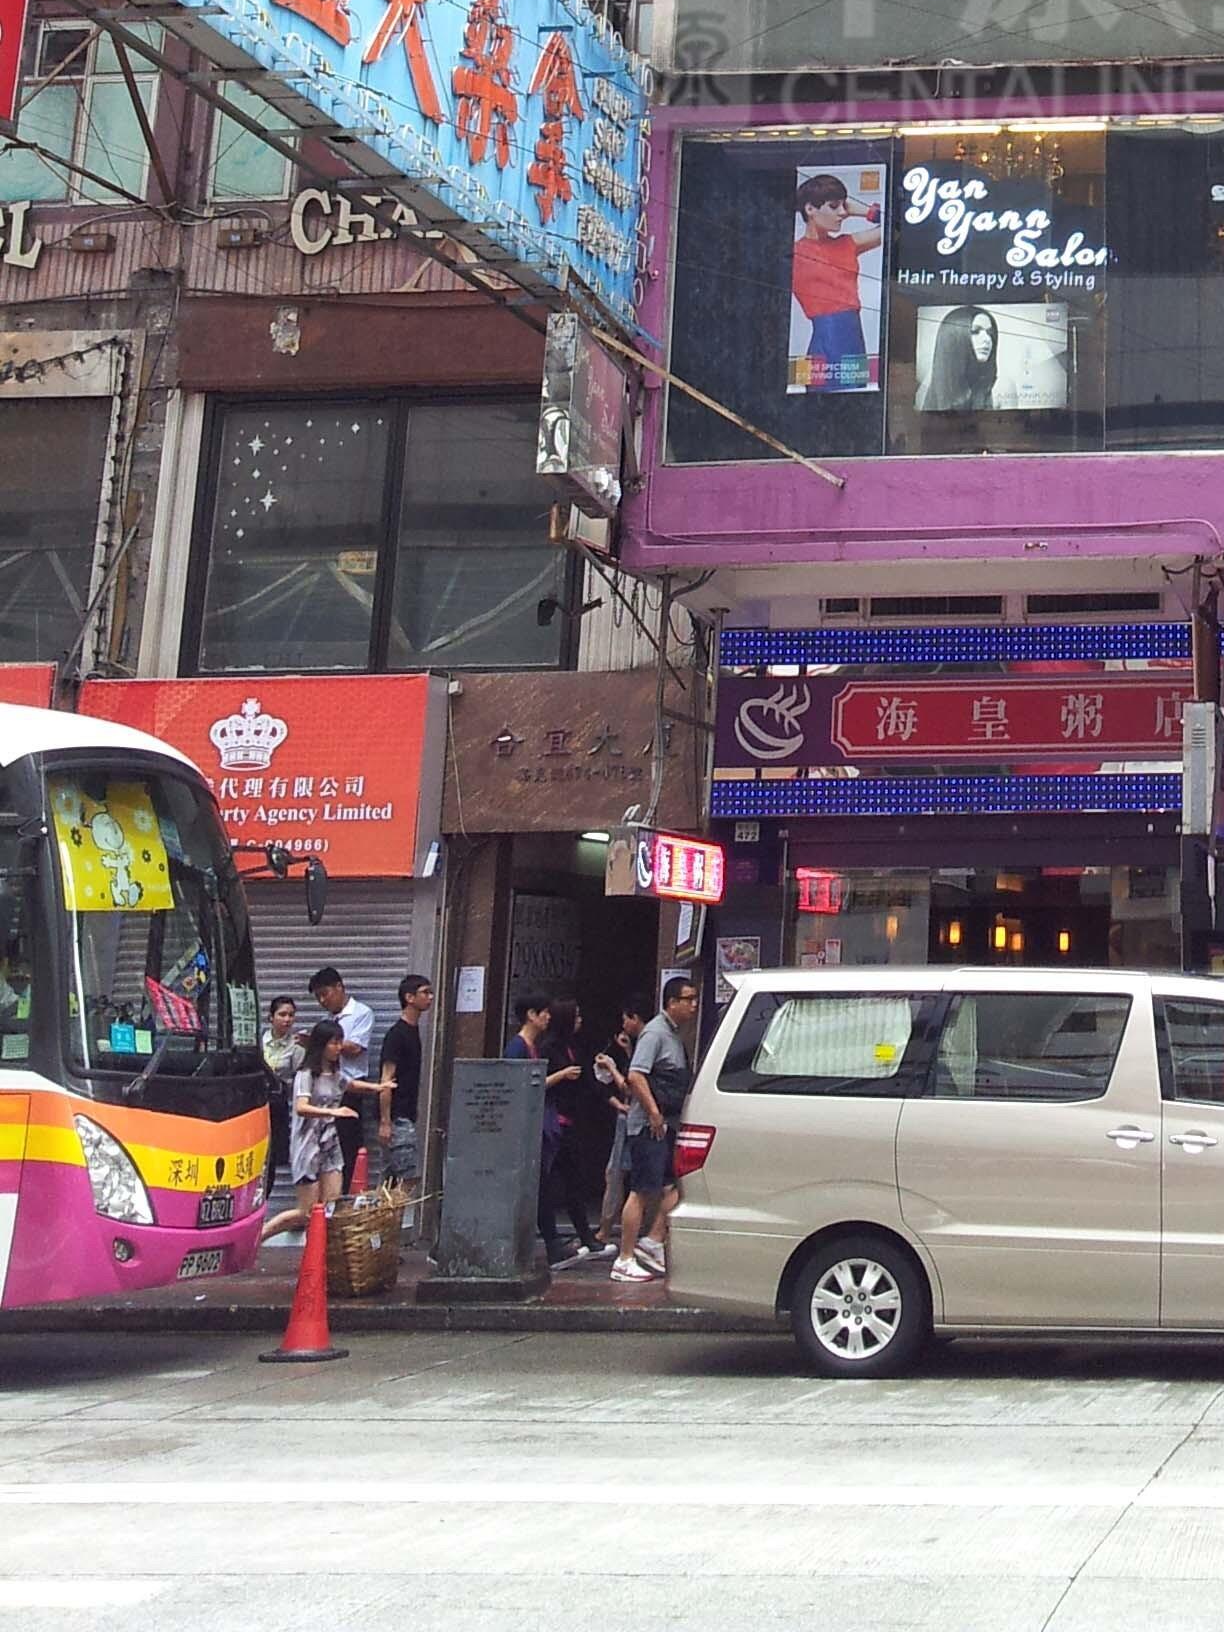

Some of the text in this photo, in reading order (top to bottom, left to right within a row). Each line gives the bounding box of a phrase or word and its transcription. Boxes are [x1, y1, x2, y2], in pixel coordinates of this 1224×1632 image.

[903, 167, 988, 225] Yan
[936, 199, 1051, 256] Yann
[897, 269, 1096, 290] Hair Therapy & Styling
[206, 776, 365, 800] 代理有限公司
[254, 803, 319, 826] Agency
[322, 801, 393, 821] Limited
[168, 1157, 199, 1187] 深圳
